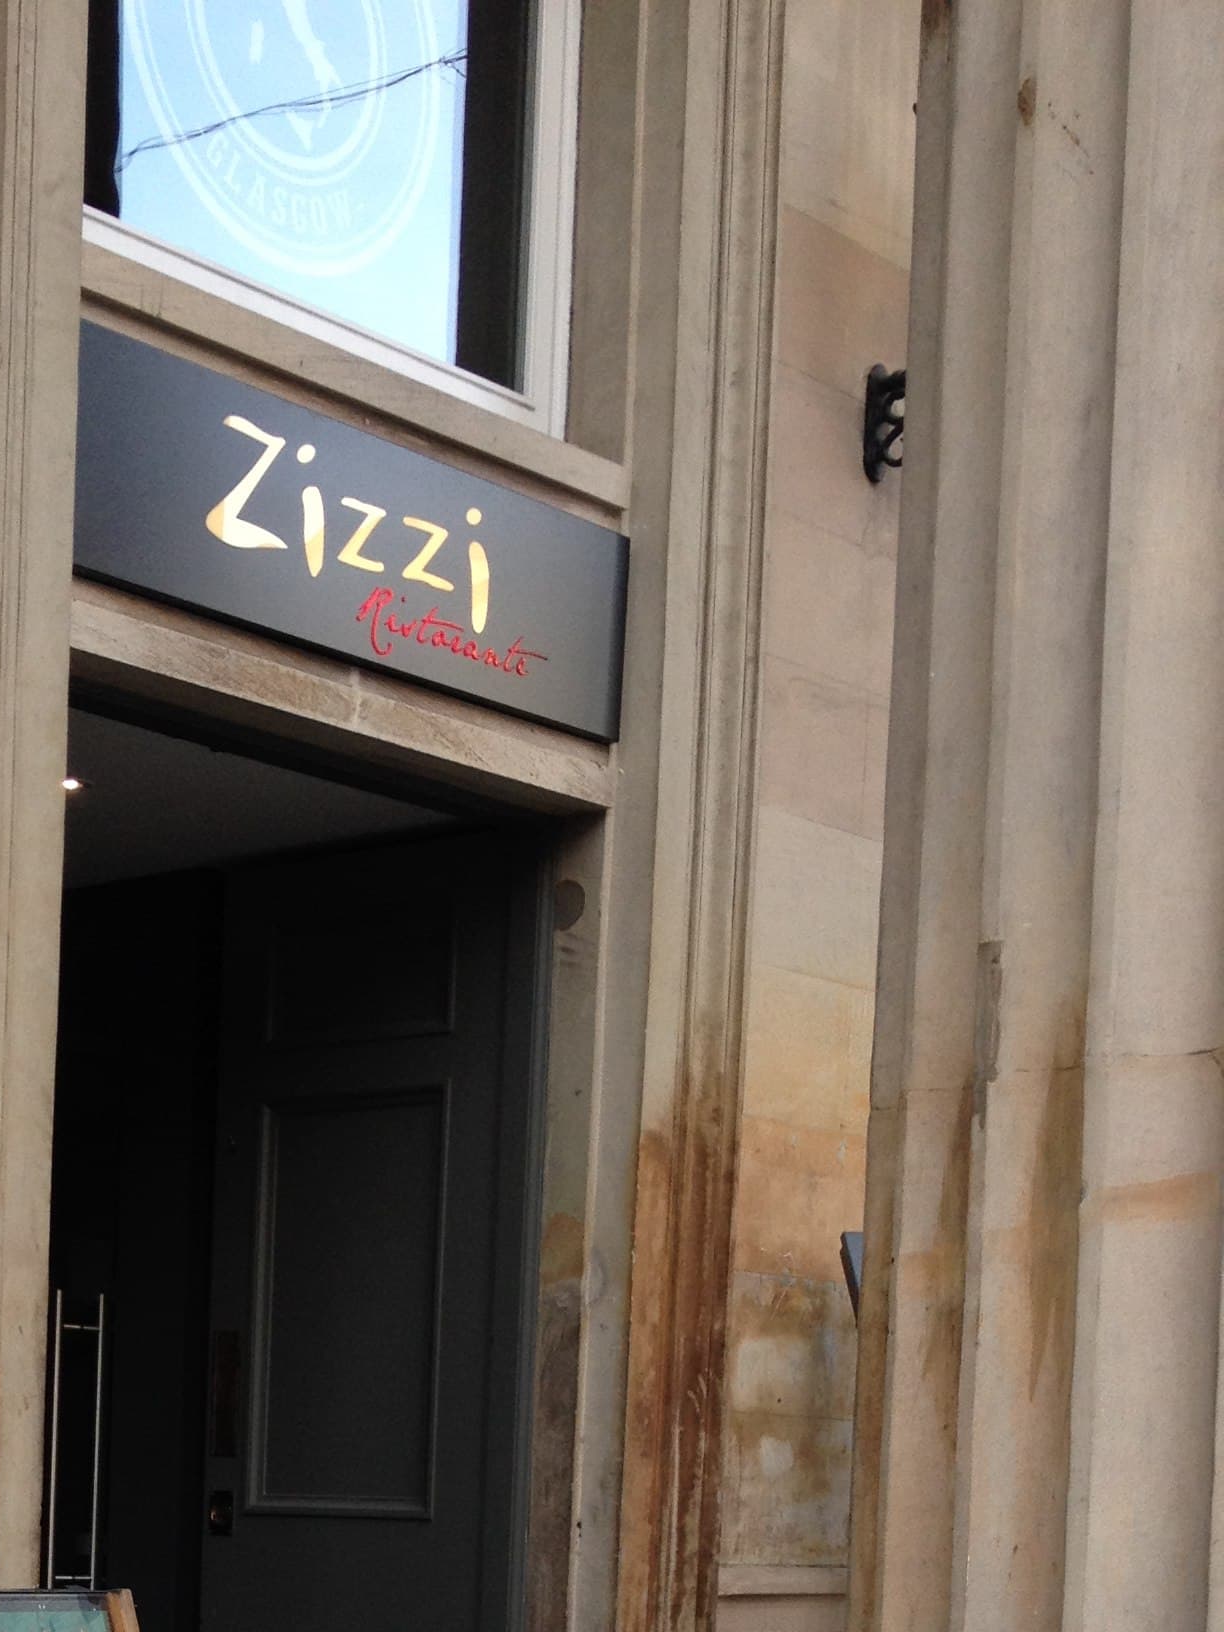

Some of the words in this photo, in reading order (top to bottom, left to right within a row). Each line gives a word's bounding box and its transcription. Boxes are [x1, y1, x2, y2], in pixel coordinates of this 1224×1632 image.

[205, 134, 351, 234] GLASGOW
[206, 414, 490, 634] Zizzi
[356, 586, 548, 676] Ristorante
